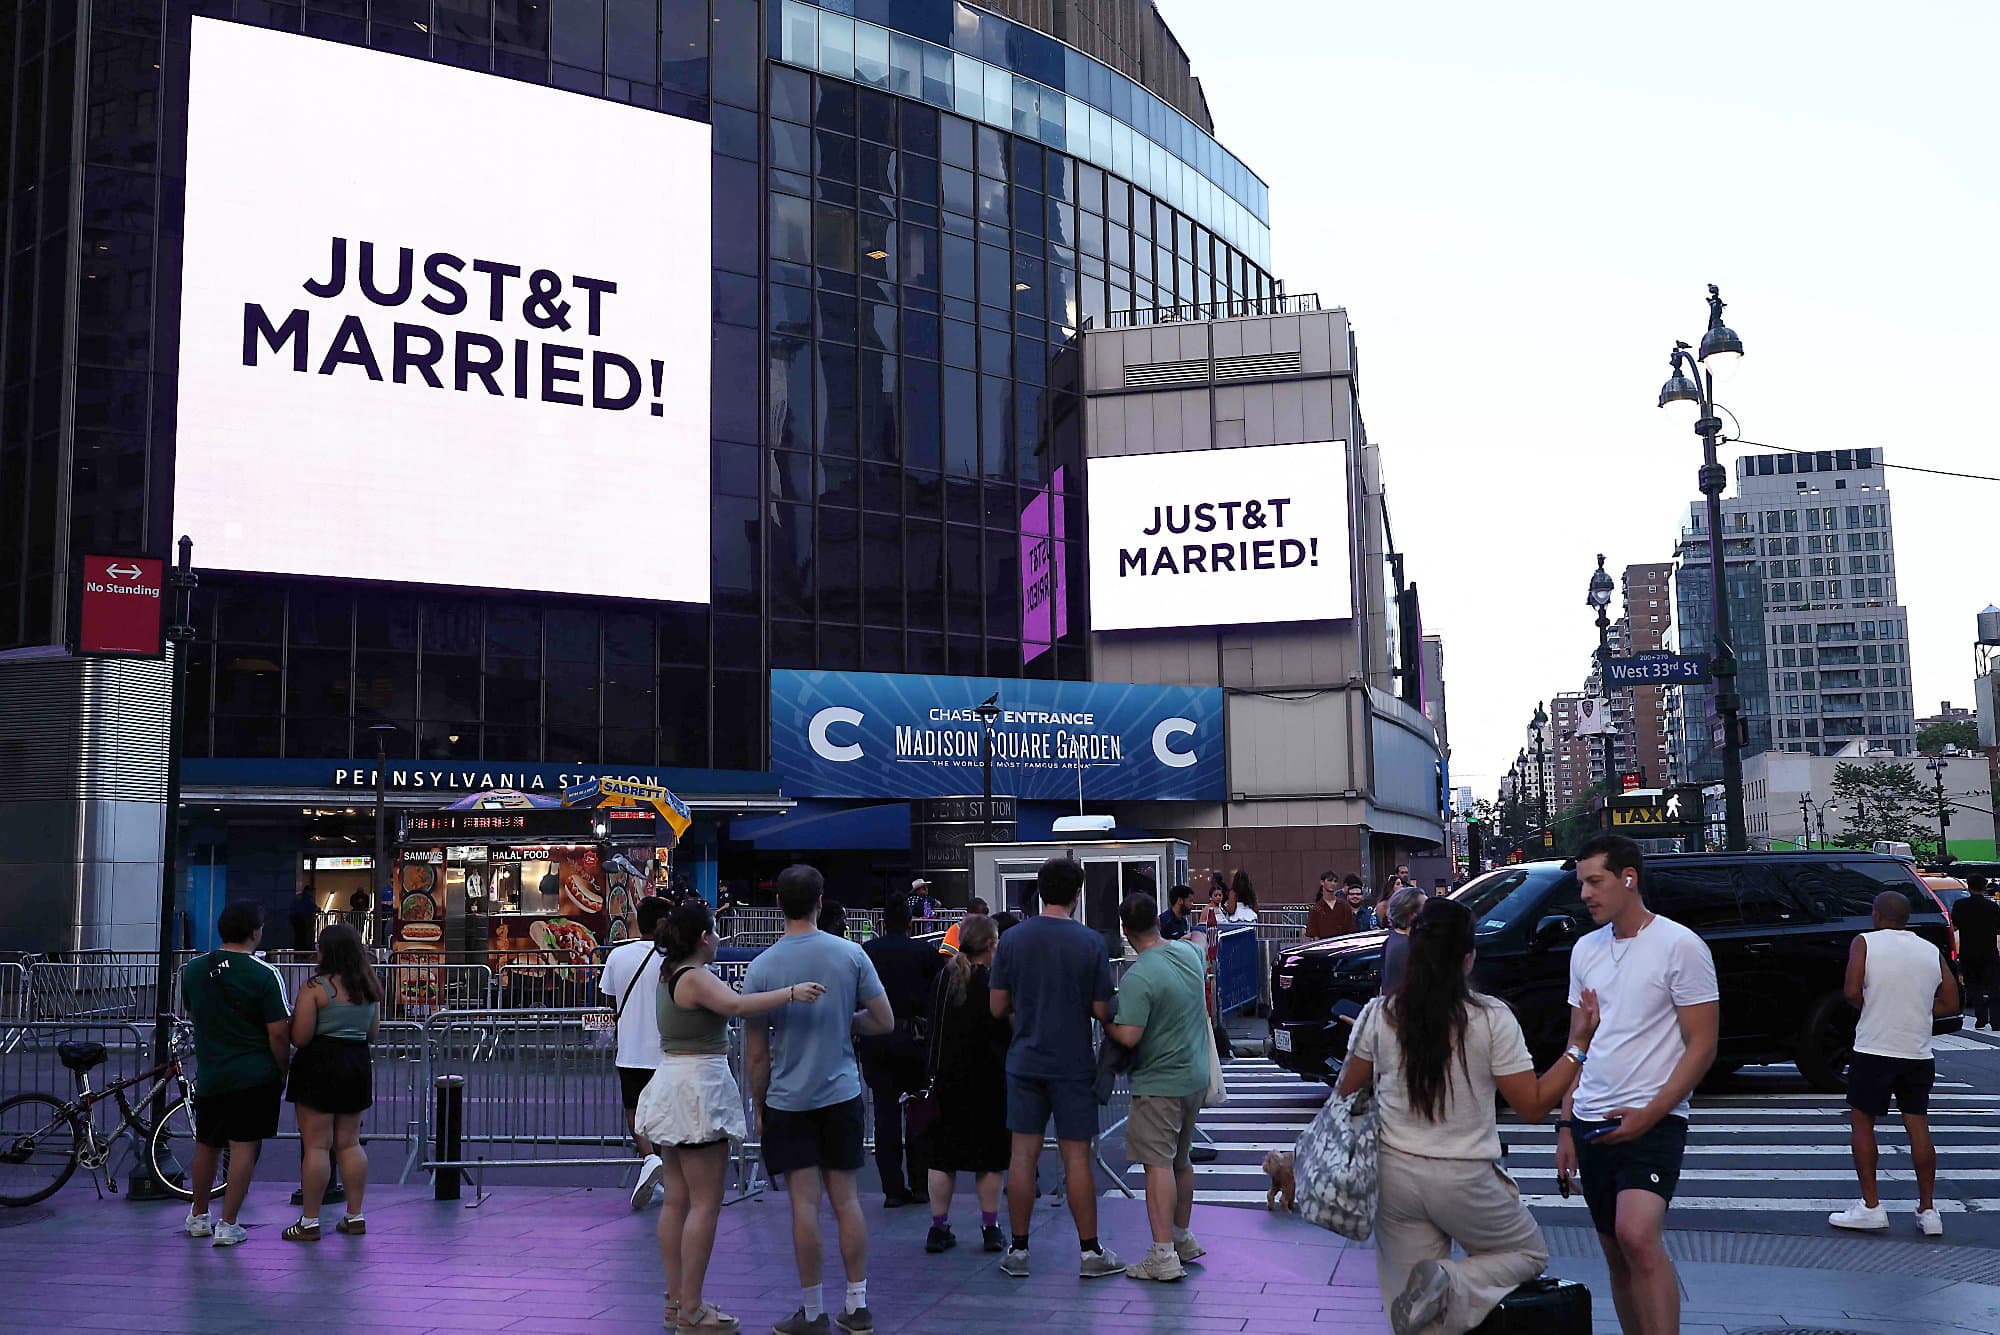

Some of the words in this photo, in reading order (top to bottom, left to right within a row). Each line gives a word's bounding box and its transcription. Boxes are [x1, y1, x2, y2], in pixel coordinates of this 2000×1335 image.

[303, 237, 617, 337] JUST&T
[243, 302, 665, 417] MARRIED!
[1143, 497, 1291, 537] JUST&T
[1120, 537, 1319, 578] MARRIED!
[86, 582, 103, 593] No
[106, 583, 160, 598] Standing
[1611, 664, 1649, 679] West
[1653, 661, 1679, 677] 33rd
[1684, 662, 1699, 676] St
[929, 708, 981, 722] CHASE
[1003, 711, 1094, 725] ENTRANCE
[809, 707, 865, 762] C
[896, 725, 978, 757] MADISON
[987, 728, 1051, 760] SQUARE
[1152, 717, 1198, 768] C
[560, 774, 658, 788] STON
[604, 782, 663, 798] SABRETT
[969, 801, 1011, 816] STTION
[403, 851, 443, 861] SAMMY'S
[492, 851, 522, 860] HALAL
[523, 850, 550, 860] FOOD
